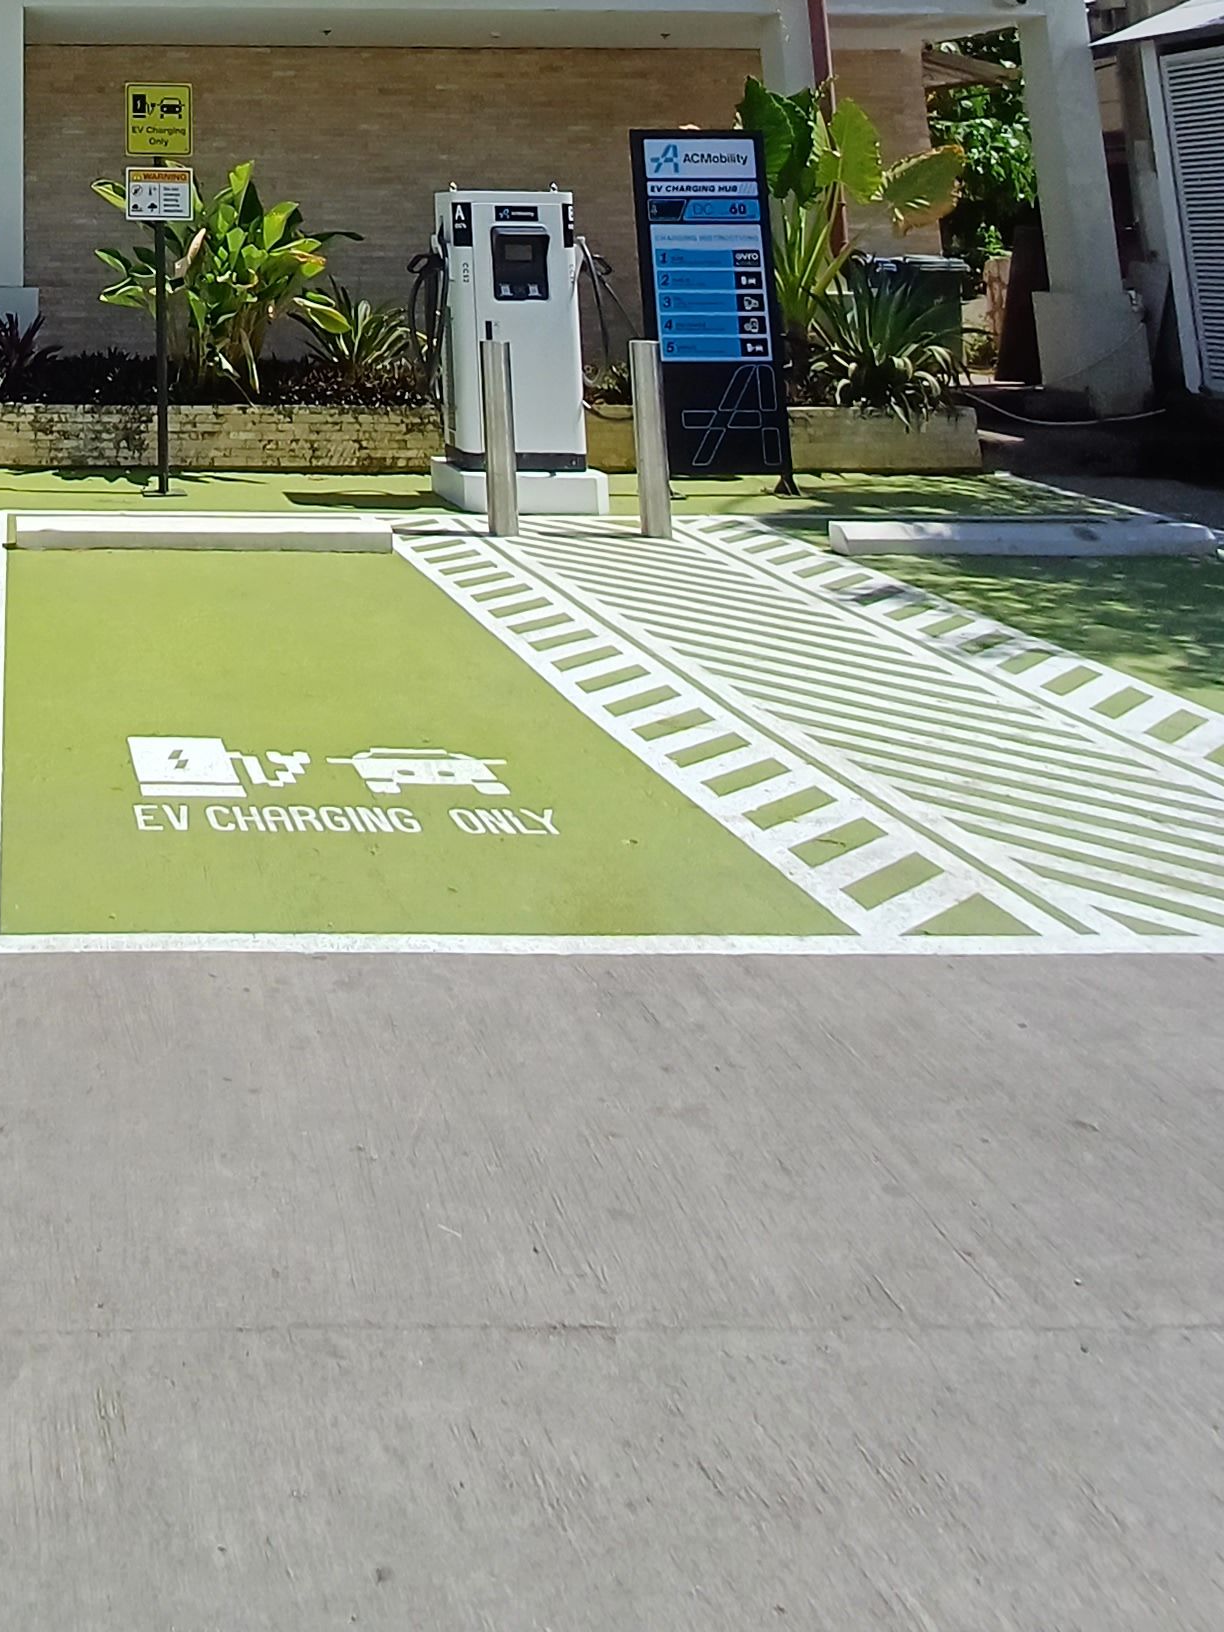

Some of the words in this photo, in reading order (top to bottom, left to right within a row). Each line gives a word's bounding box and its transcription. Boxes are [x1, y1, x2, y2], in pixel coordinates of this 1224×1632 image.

[131, 126, 143, 134] EV
[146, 126, 186, 136] Charging
[148, 137, 169, 146] Only
[683, 153, 748, 166] ACMobility
[142, 172, 187, 181] WARNING
[650, 185, 663, 193] EV
[665, 185, 715, 193] CHARGING
[718, 185, 738, 193] HUB
[454, 204, 465, 220] A
[693, 203, 712, 215] DC
[729, 203, 747, 215] 60
[660, 252, 668, 264] 1
[661, 274, 670, 286] 2
[663, 296, 671, 307] 3
[664, 319, 673, 330] 4
[666, 342, 675, 353] 5
[133, 805, 189, 831] EV
[206, 806, 422, 834] CHARGING
[448, 808, 561, 835] ONLY
